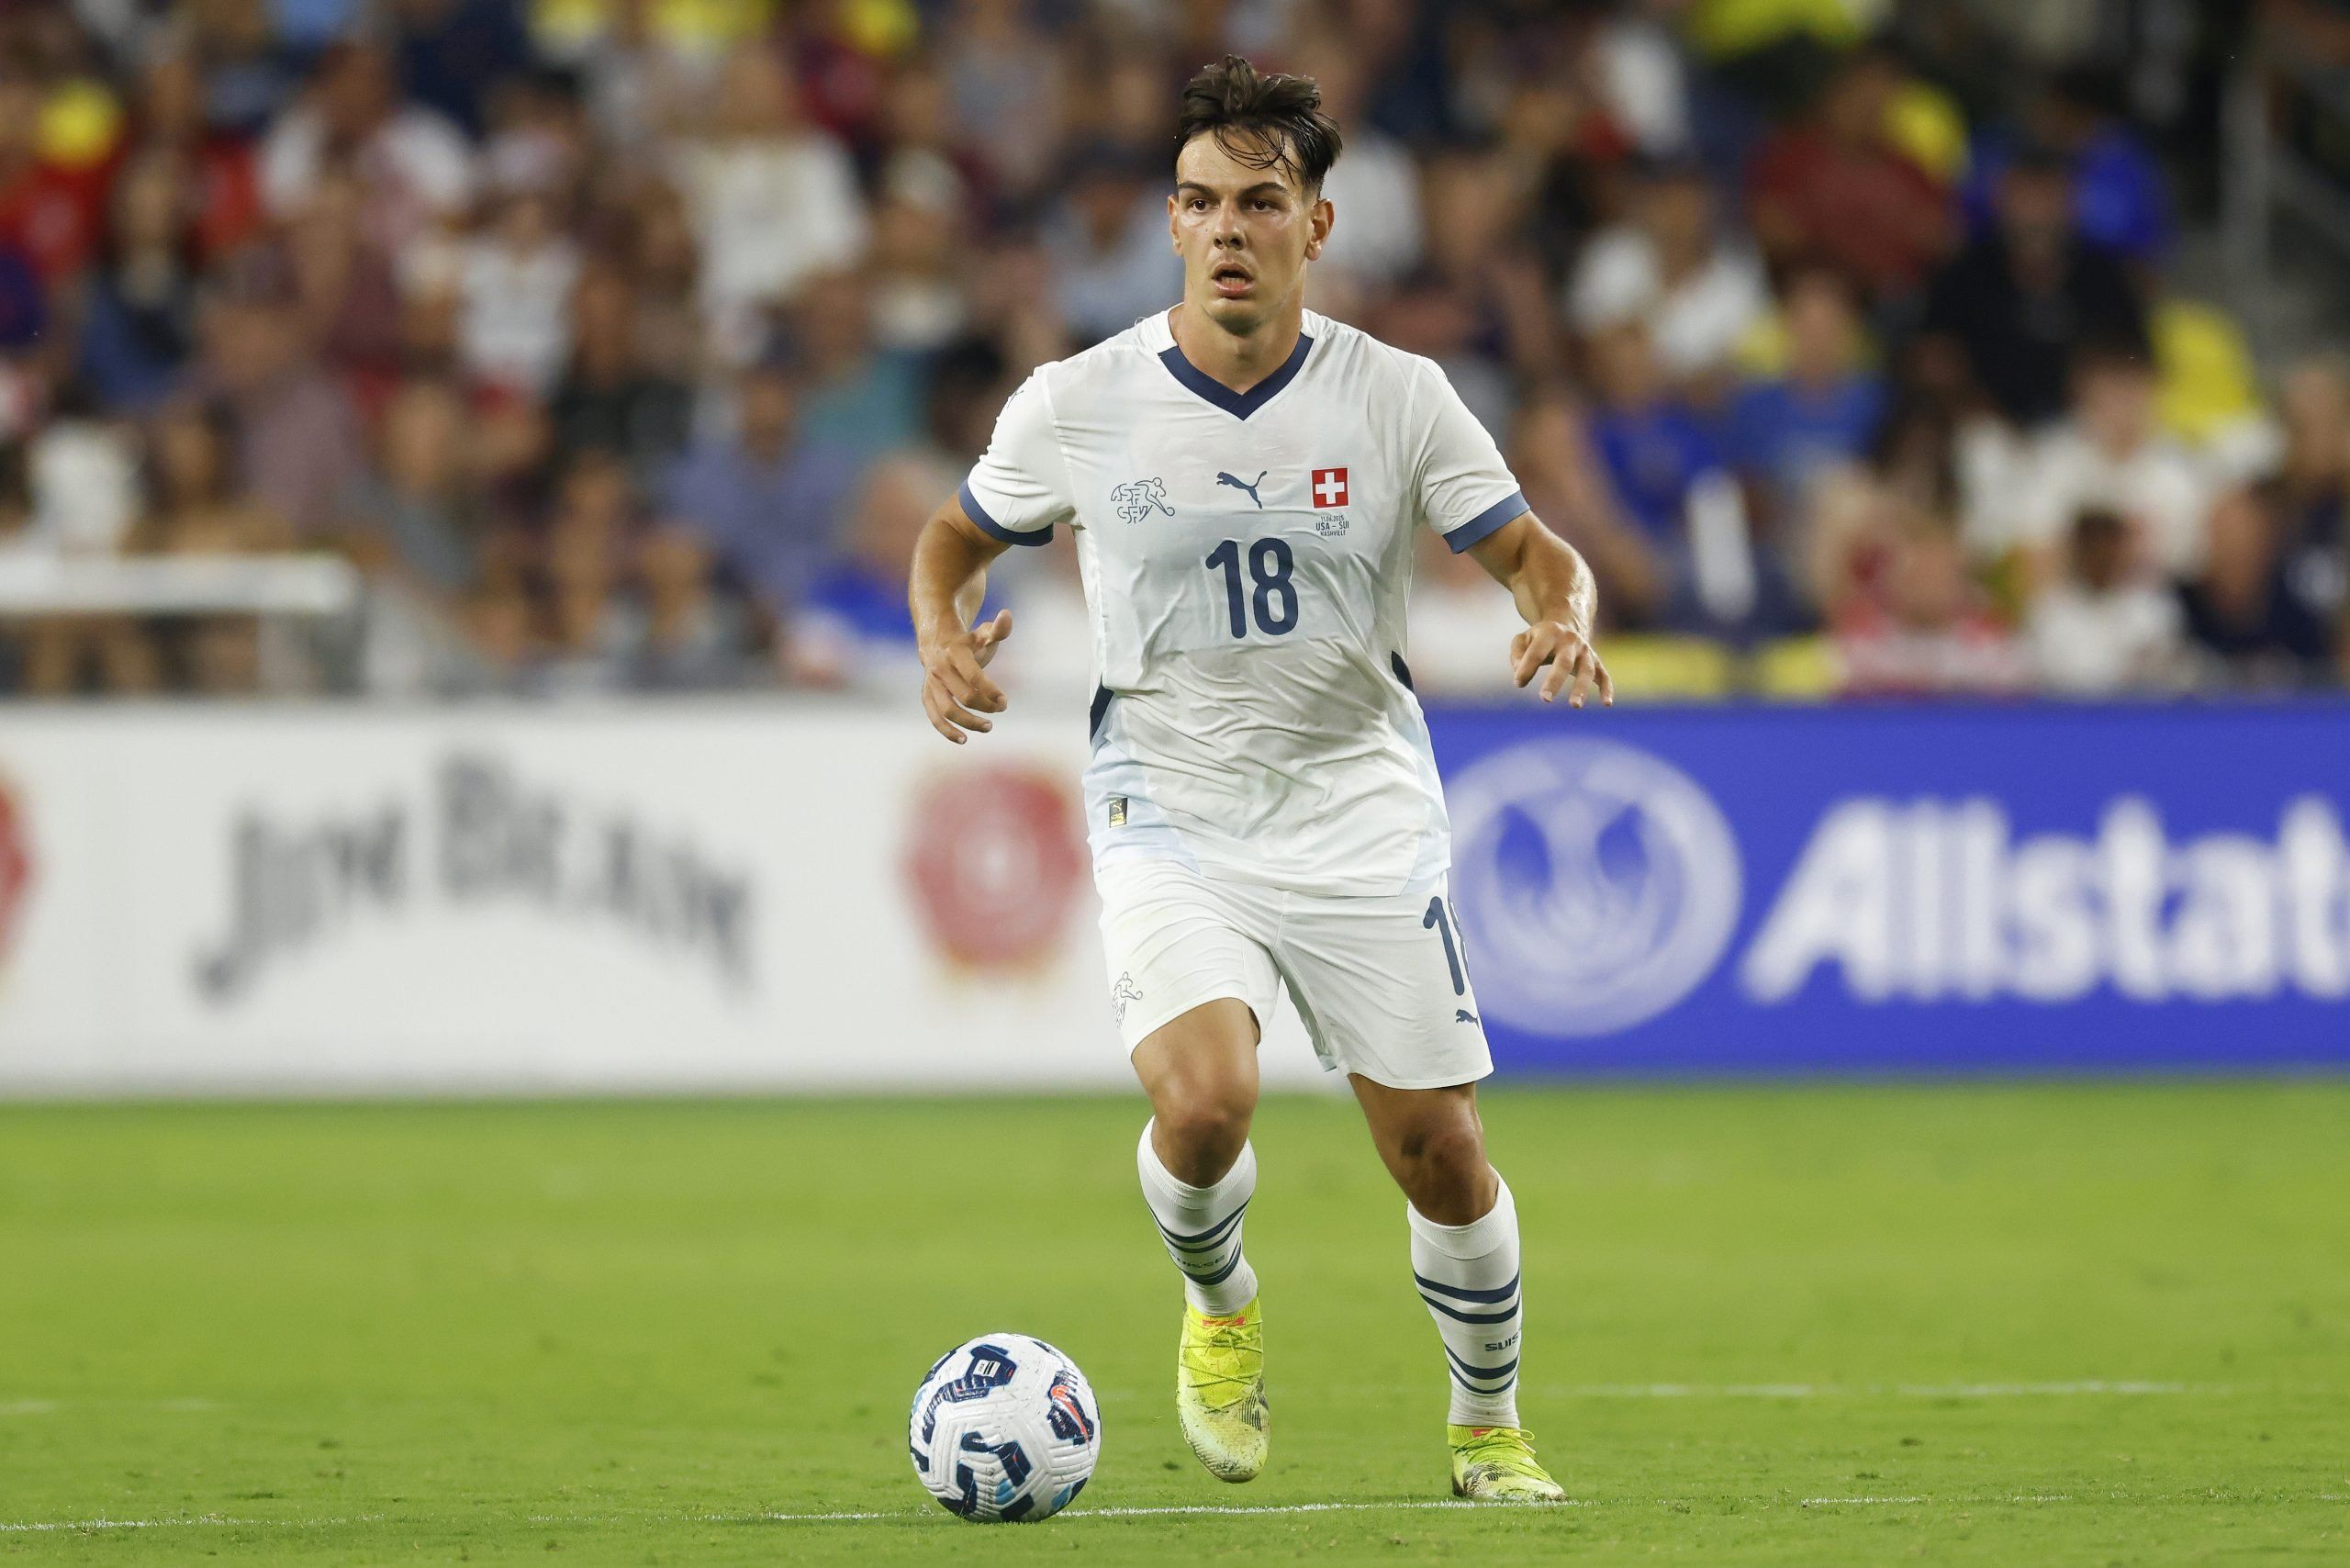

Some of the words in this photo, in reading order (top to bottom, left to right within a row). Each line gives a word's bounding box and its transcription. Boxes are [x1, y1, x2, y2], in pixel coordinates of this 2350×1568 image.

[1315, 521, 1331, 532] USA
[1338, 521, 1349, 530] SUI
[1320, 529, 1346, 537] NASHVILLE
[1204, 537, 1299, 639] 18
[1423, 896, 1471, 996] 1
[1484, 1327, 1521, 1351] SUIS
